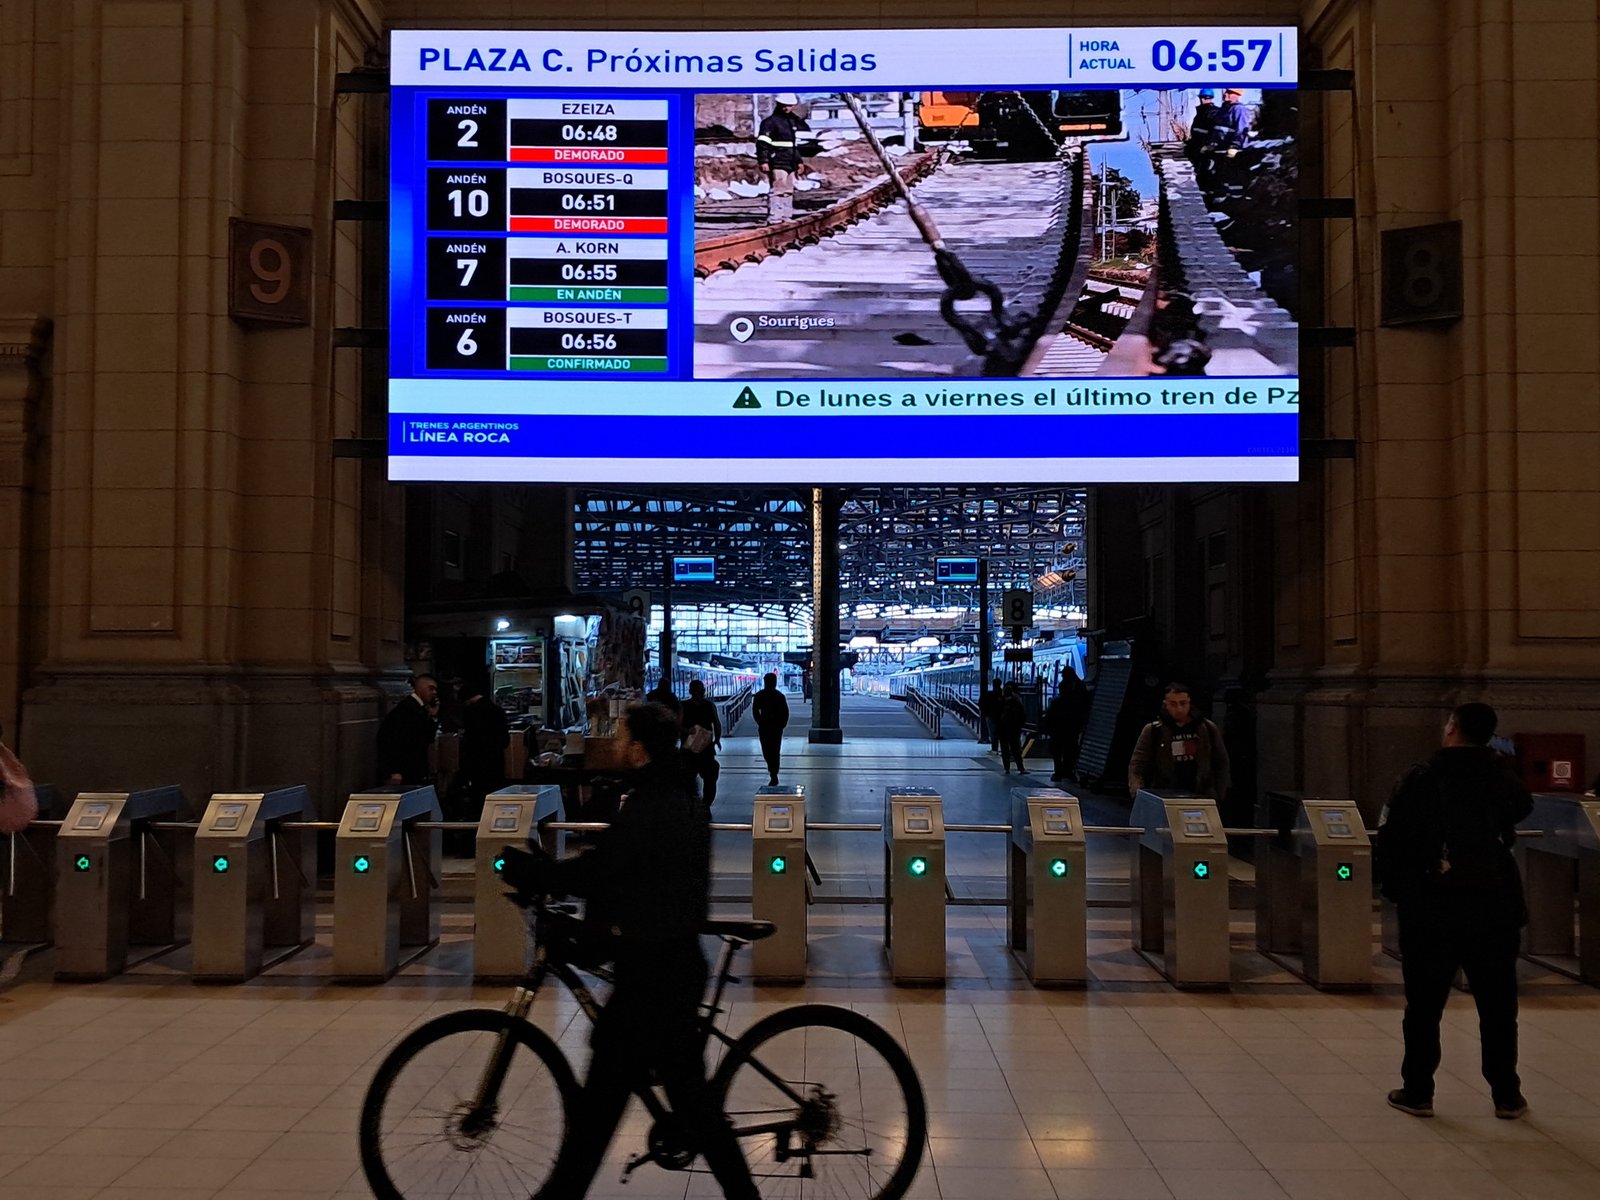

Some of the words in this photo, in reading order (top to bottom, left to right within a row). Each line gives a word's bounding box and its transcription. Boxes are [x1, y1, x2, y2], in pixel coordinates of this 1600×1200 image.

[1079, 41, 1120, 51] HORA
[419, 48, 532, 72] PLAZA
[543, 49, 573, 72] C.
[587, 48, 743, 73] Próximas
[755, 48, 877, 72] Salidas
[1151, 39, 1273, 72] 06:57
[1079, 58, 1135, 70] ACTUAL
[447, 105, 487, 114] ANDÉN
[562, 104, 615, 115] EZEIZA
[457, 120, 478, 147] 2
[562, 125, 617, 141] 06:48
[554, 150, 625, 160] DEMORADO
[447, 174, 487, 184] ANDÉN
[543, 172, 634, 185] BOSQUES-Q
[448, 190, 489, 217] 10
[562, 195, 615, 210] 06:51
[554, 220, 624, 230] DEMORADO
[446, 244, 486, 253] ANDÉN
[556, 242, 571, 254] A.
[576, 242, 619, 254] KORN
[249, 238, 291, 304] 9
[457, 259, 478, 286] 7
[562, 264, 617, 280] 06:55
[1403, 240, 1442, 307] 8
[557, 290, 574, 300] EN
[578, 289, 622, 300] ANDÉN
[446, 314, 486, 323] ANDÉN
[544, 312, 632, 324] BOSQUES-T
[759, 314, 835, 330] Sourigues
[456, 328, 478, 356] 6
[561, 334, 616, 350] 06:56
[547, 359, 630, 369] CONFIRMADO
[775, 390, 811, 408] De
[820, 389, 894, 407] lunes
[900, 394, 916, 407] a
[925, 389, 1024, 407] viernes
[1034, 388, 1056, 407] el
[1066, 388, 1151, 406] último
[1161, 390, 1215, 406] tren
[1224, 387, 1258, 406] de
[1268, 387, 1299, 404] Pz
[452, 422, 519, 430] ARGENTINOS
[410, 430, 458, 442] LÍNEA
[464, 433, 510, 443] ROCA
[629, 595, 643, 618] 9
[1011, 598, 1024, 621] 8
